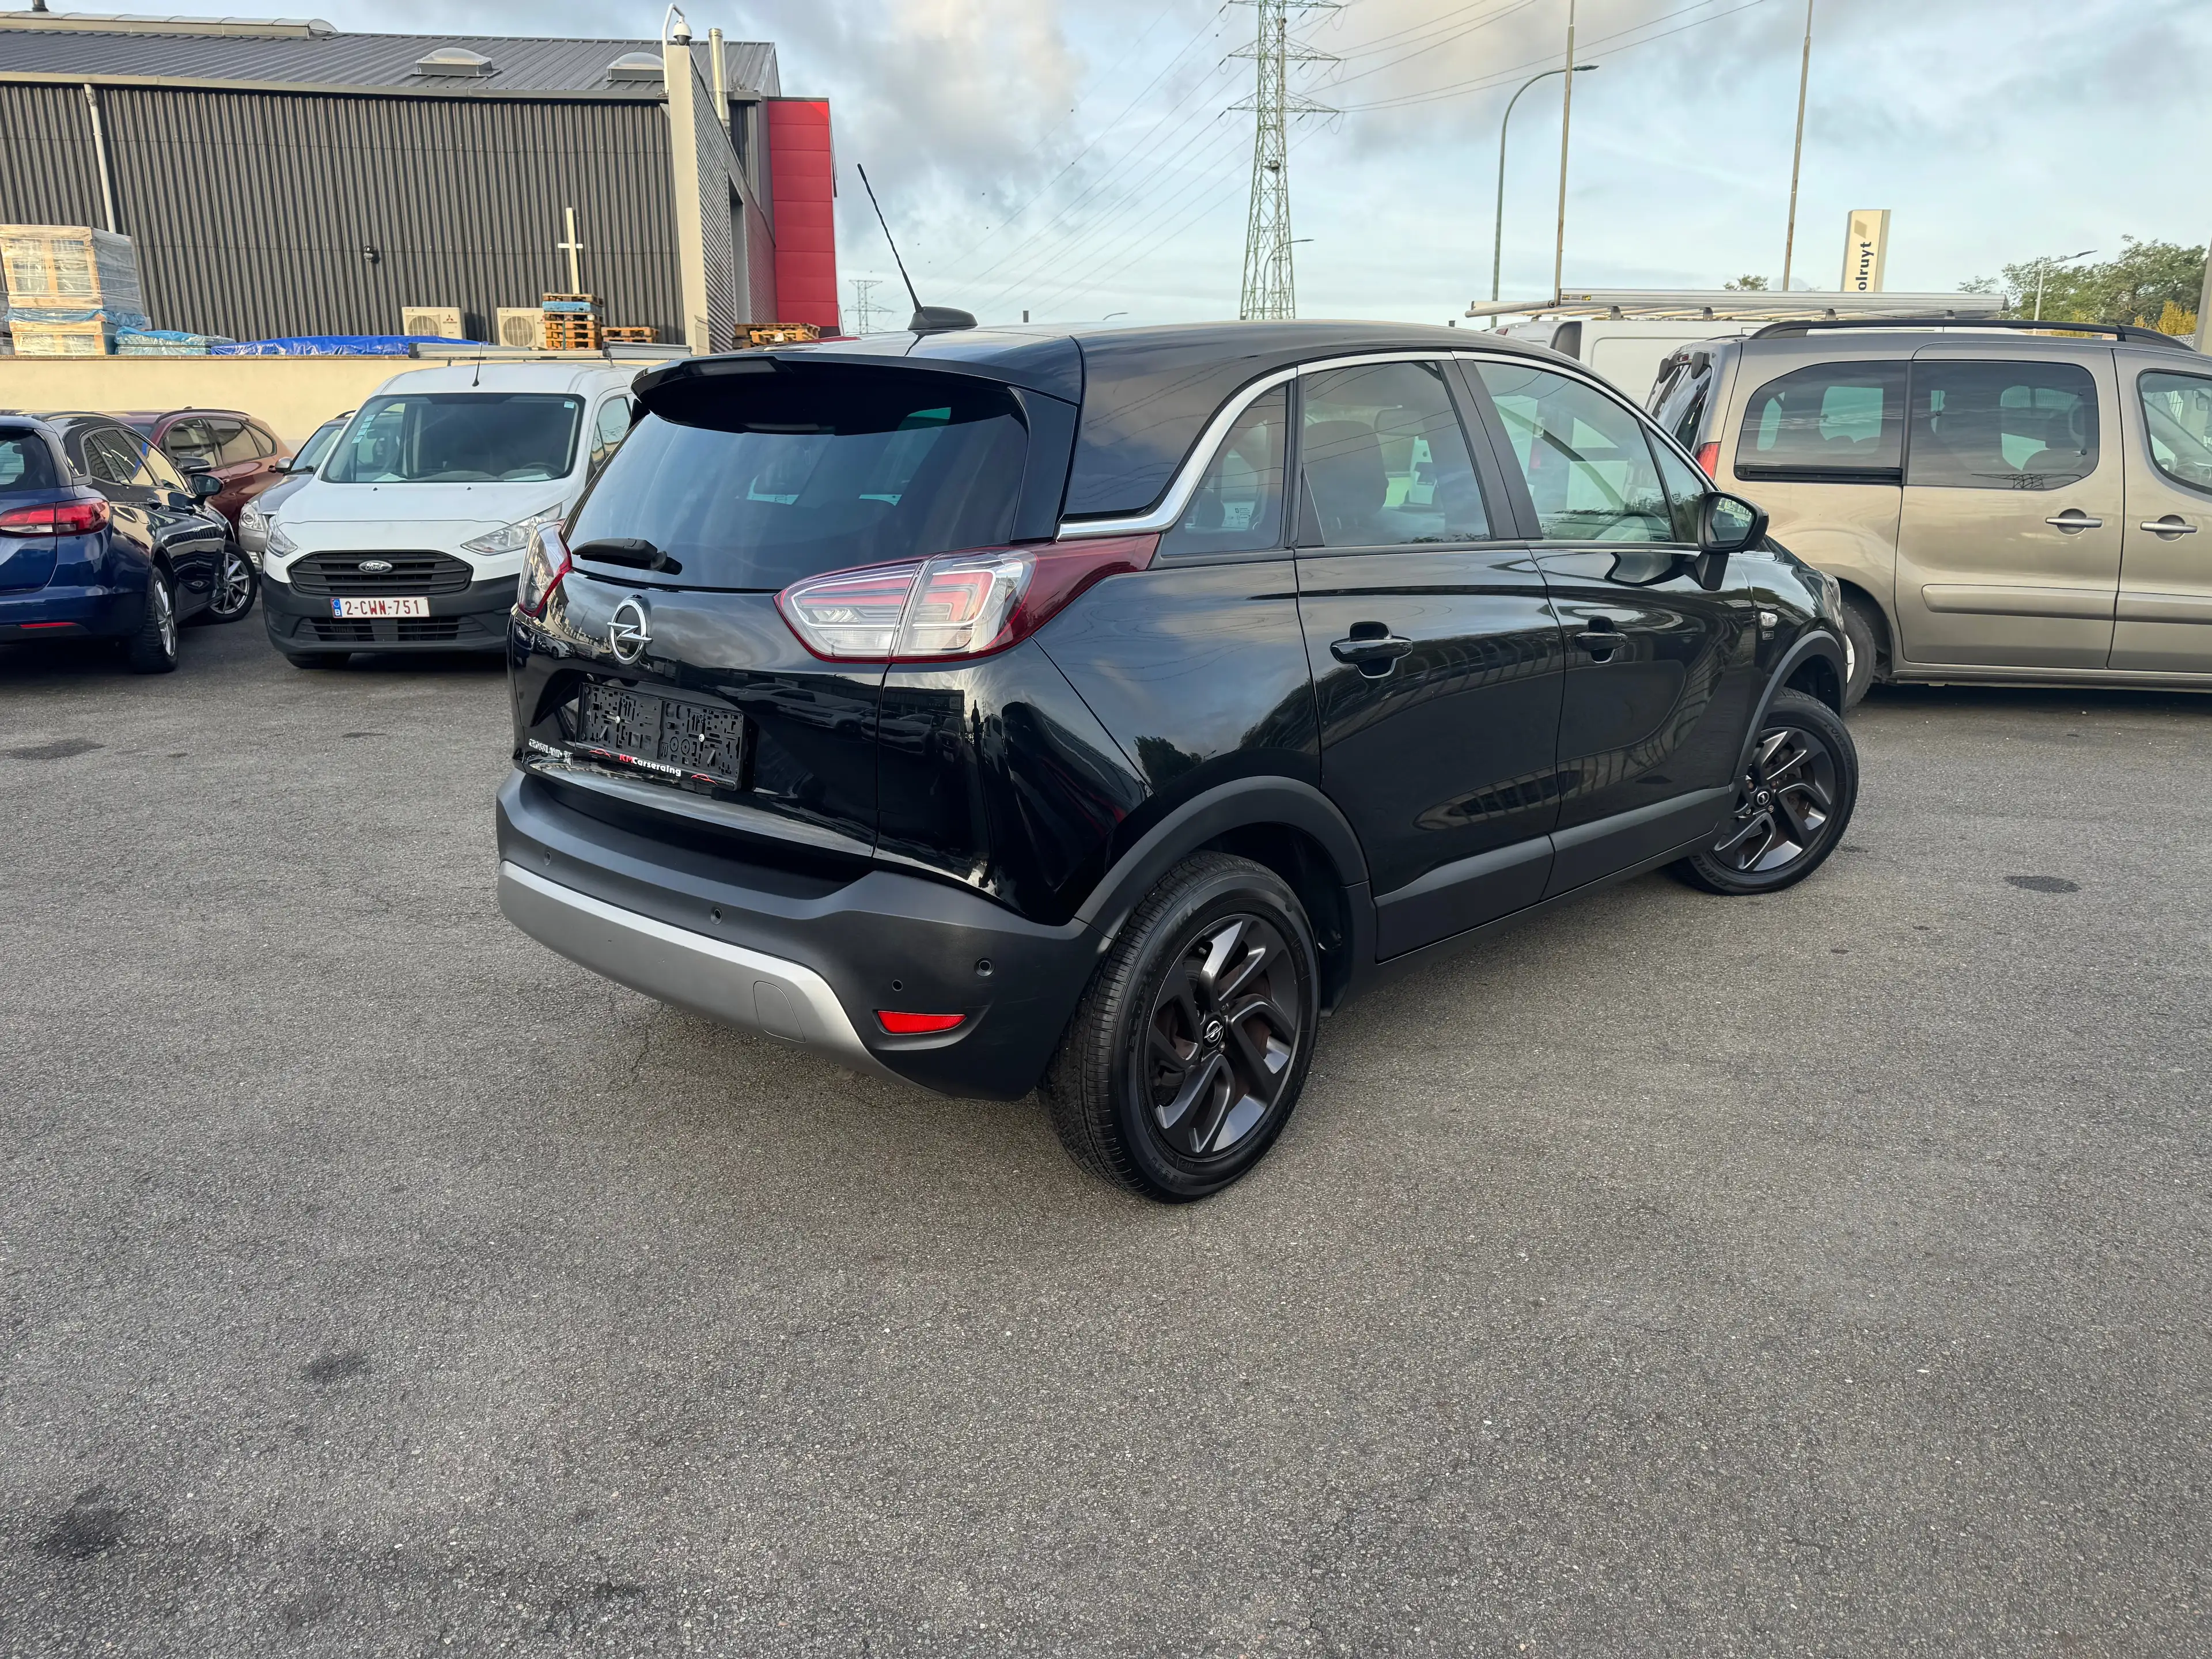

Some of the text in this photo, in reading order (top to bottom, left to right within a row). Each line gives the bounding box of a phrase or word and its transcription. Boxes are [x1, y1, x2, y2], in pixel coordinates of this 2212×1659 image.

[1855, 241, 1874, 291] olruyt
[365, 562, 384, 570] Ford
[345, 600, 419, 615] 2-CWN-751
